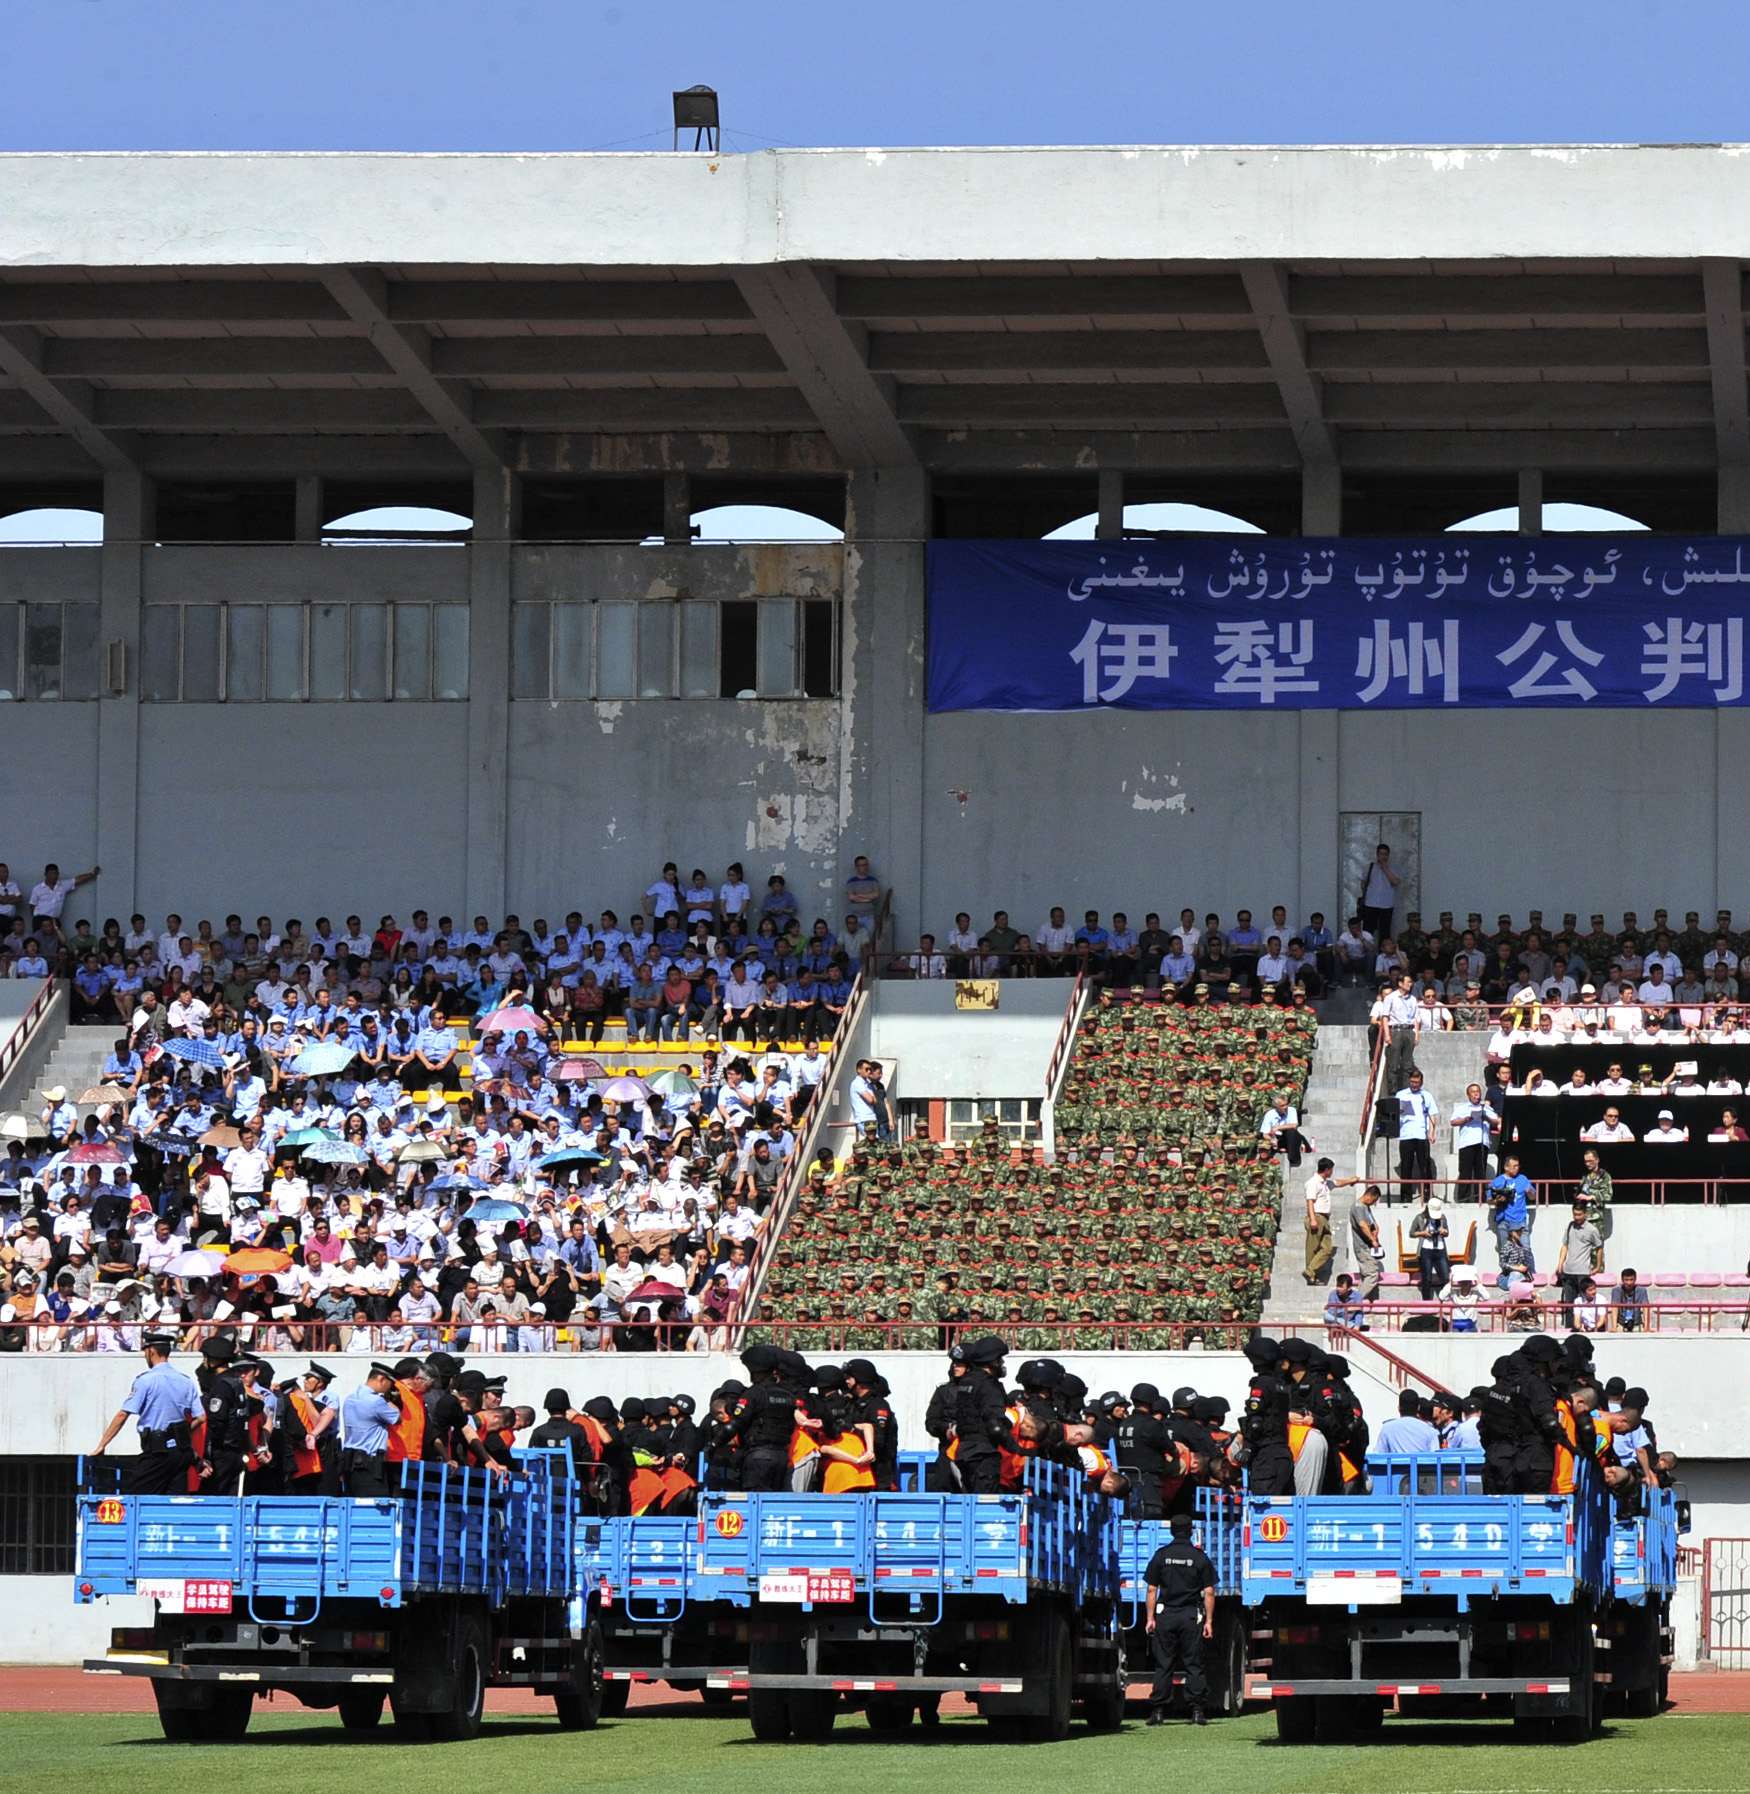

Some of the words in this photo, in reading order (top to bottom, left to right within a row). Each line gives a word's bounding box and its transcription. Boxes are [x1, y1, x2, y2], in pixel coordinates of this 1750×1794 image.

[104, 1503, 121, 1522] 13
[722, 1511, 738, 1535] 12
[1267, 1518, 1281, 1539] 11
